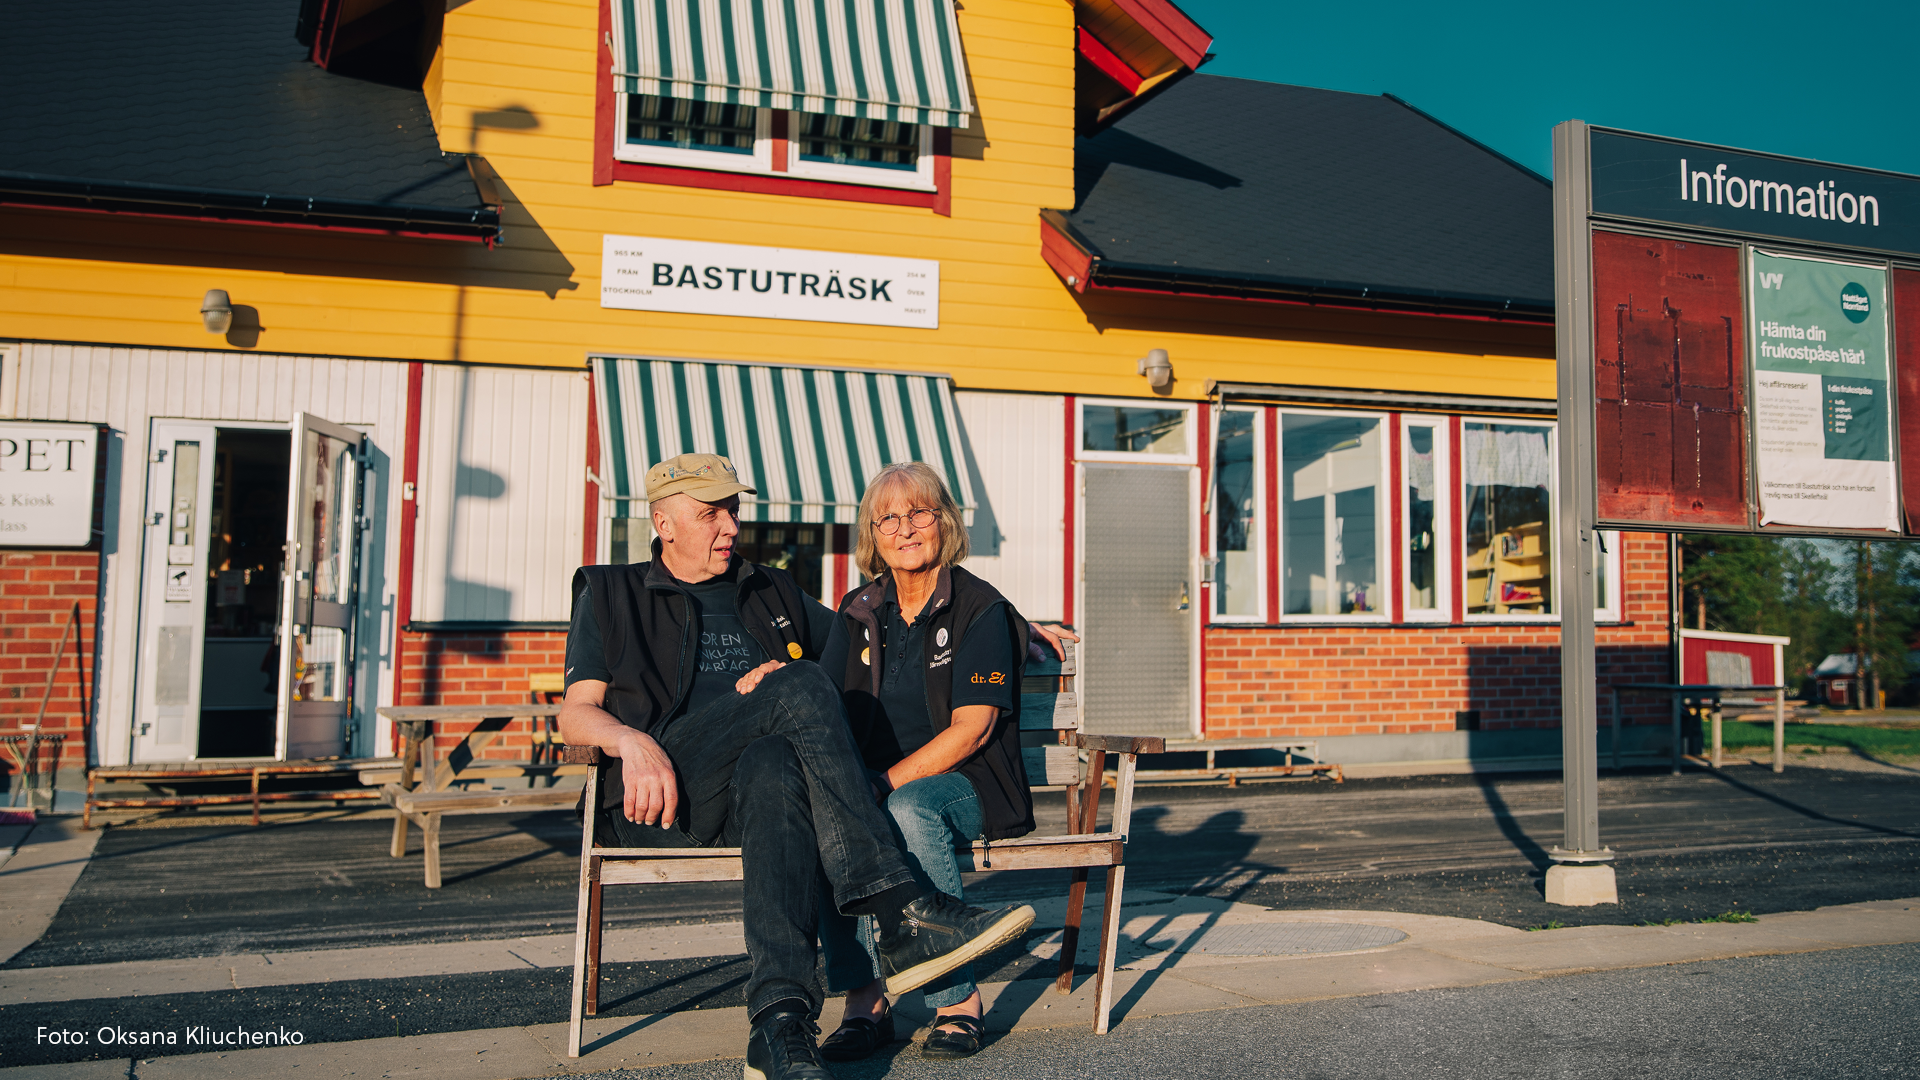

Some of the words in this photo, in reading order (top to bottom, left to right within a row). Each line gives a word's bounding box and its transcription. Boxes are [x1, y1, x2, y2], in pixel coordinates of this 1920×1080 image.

[1681, 158, 1879, 226] Information
[652, 262, 893, 302] BASTUTRÄSK
[603, 287, 652, 296] STOCKHOLM
[1760, 321, 1804, 340] Hämta
[1806, 325, 1826, 341] din
[1761, 341, 1839, 364] frukostpåse
[1839, 348, 1866, 365] här!
[11, 493, 55, 507] Kiosk
[699, 631, 718, 646] ÖR
[720, 633, 742, 646] EN
[697, 659, 750, 672] VARDAG
